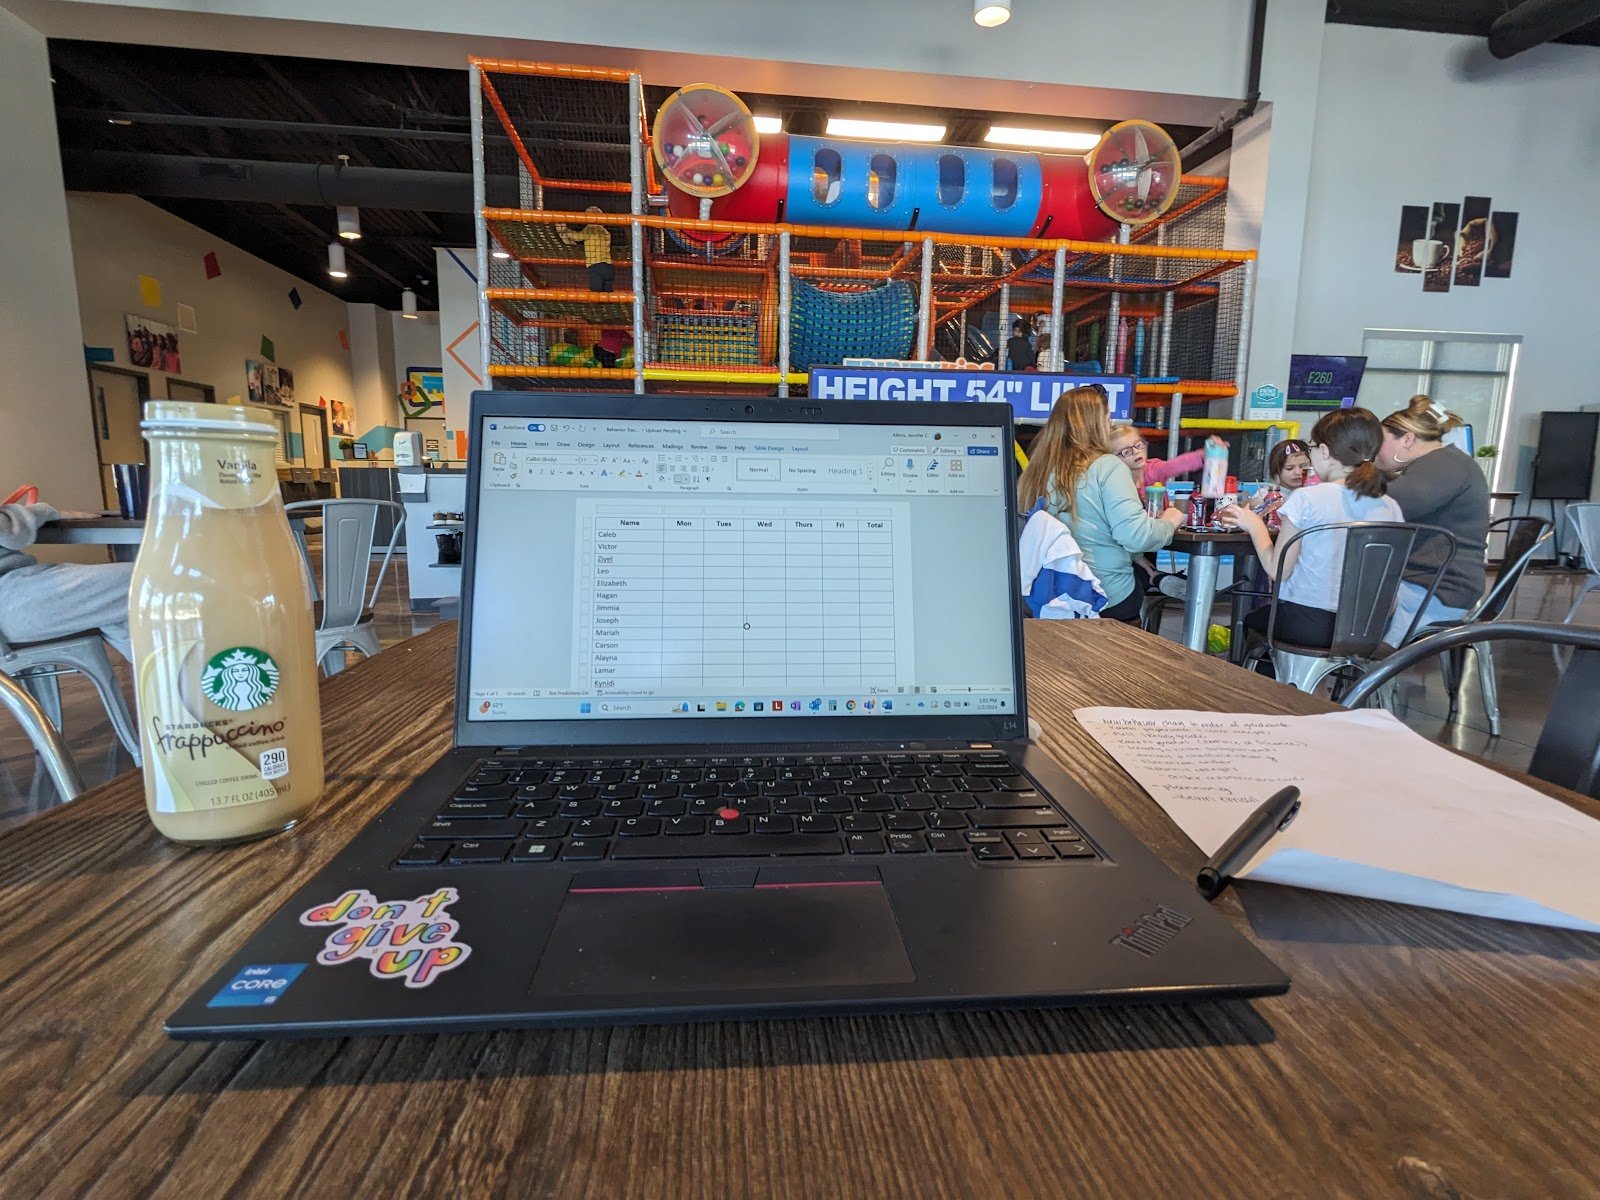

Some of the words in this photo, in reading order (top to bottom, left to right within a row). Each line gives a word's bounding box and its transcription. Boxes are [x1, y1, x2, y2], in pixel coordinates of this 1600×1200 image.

[1308, 371, 1333, 384] F260
[818, 375, 957, 402] HEIGHT
[1031, 381, 1125, 413] LIT
[828, 466, 857, 475] Heading
[795, 520, 813, 528] Thurs
[165, 720, 229, 732] STARBUCKS
[1004, 721, 1017, 729] L14
[153, 716, 285, 760] frappuccino
[263, 750, 285, 766] 290
[210, 795, 229, 807] 13.7
[232, 794, 241, 803] FL
[242, 792, 254, 801] OZ
[255, 788, 275, 800] (405
[324, 921, 451, 961] give
[244, 967, 272, 976] intel
[377, 946, 462, 983] up
